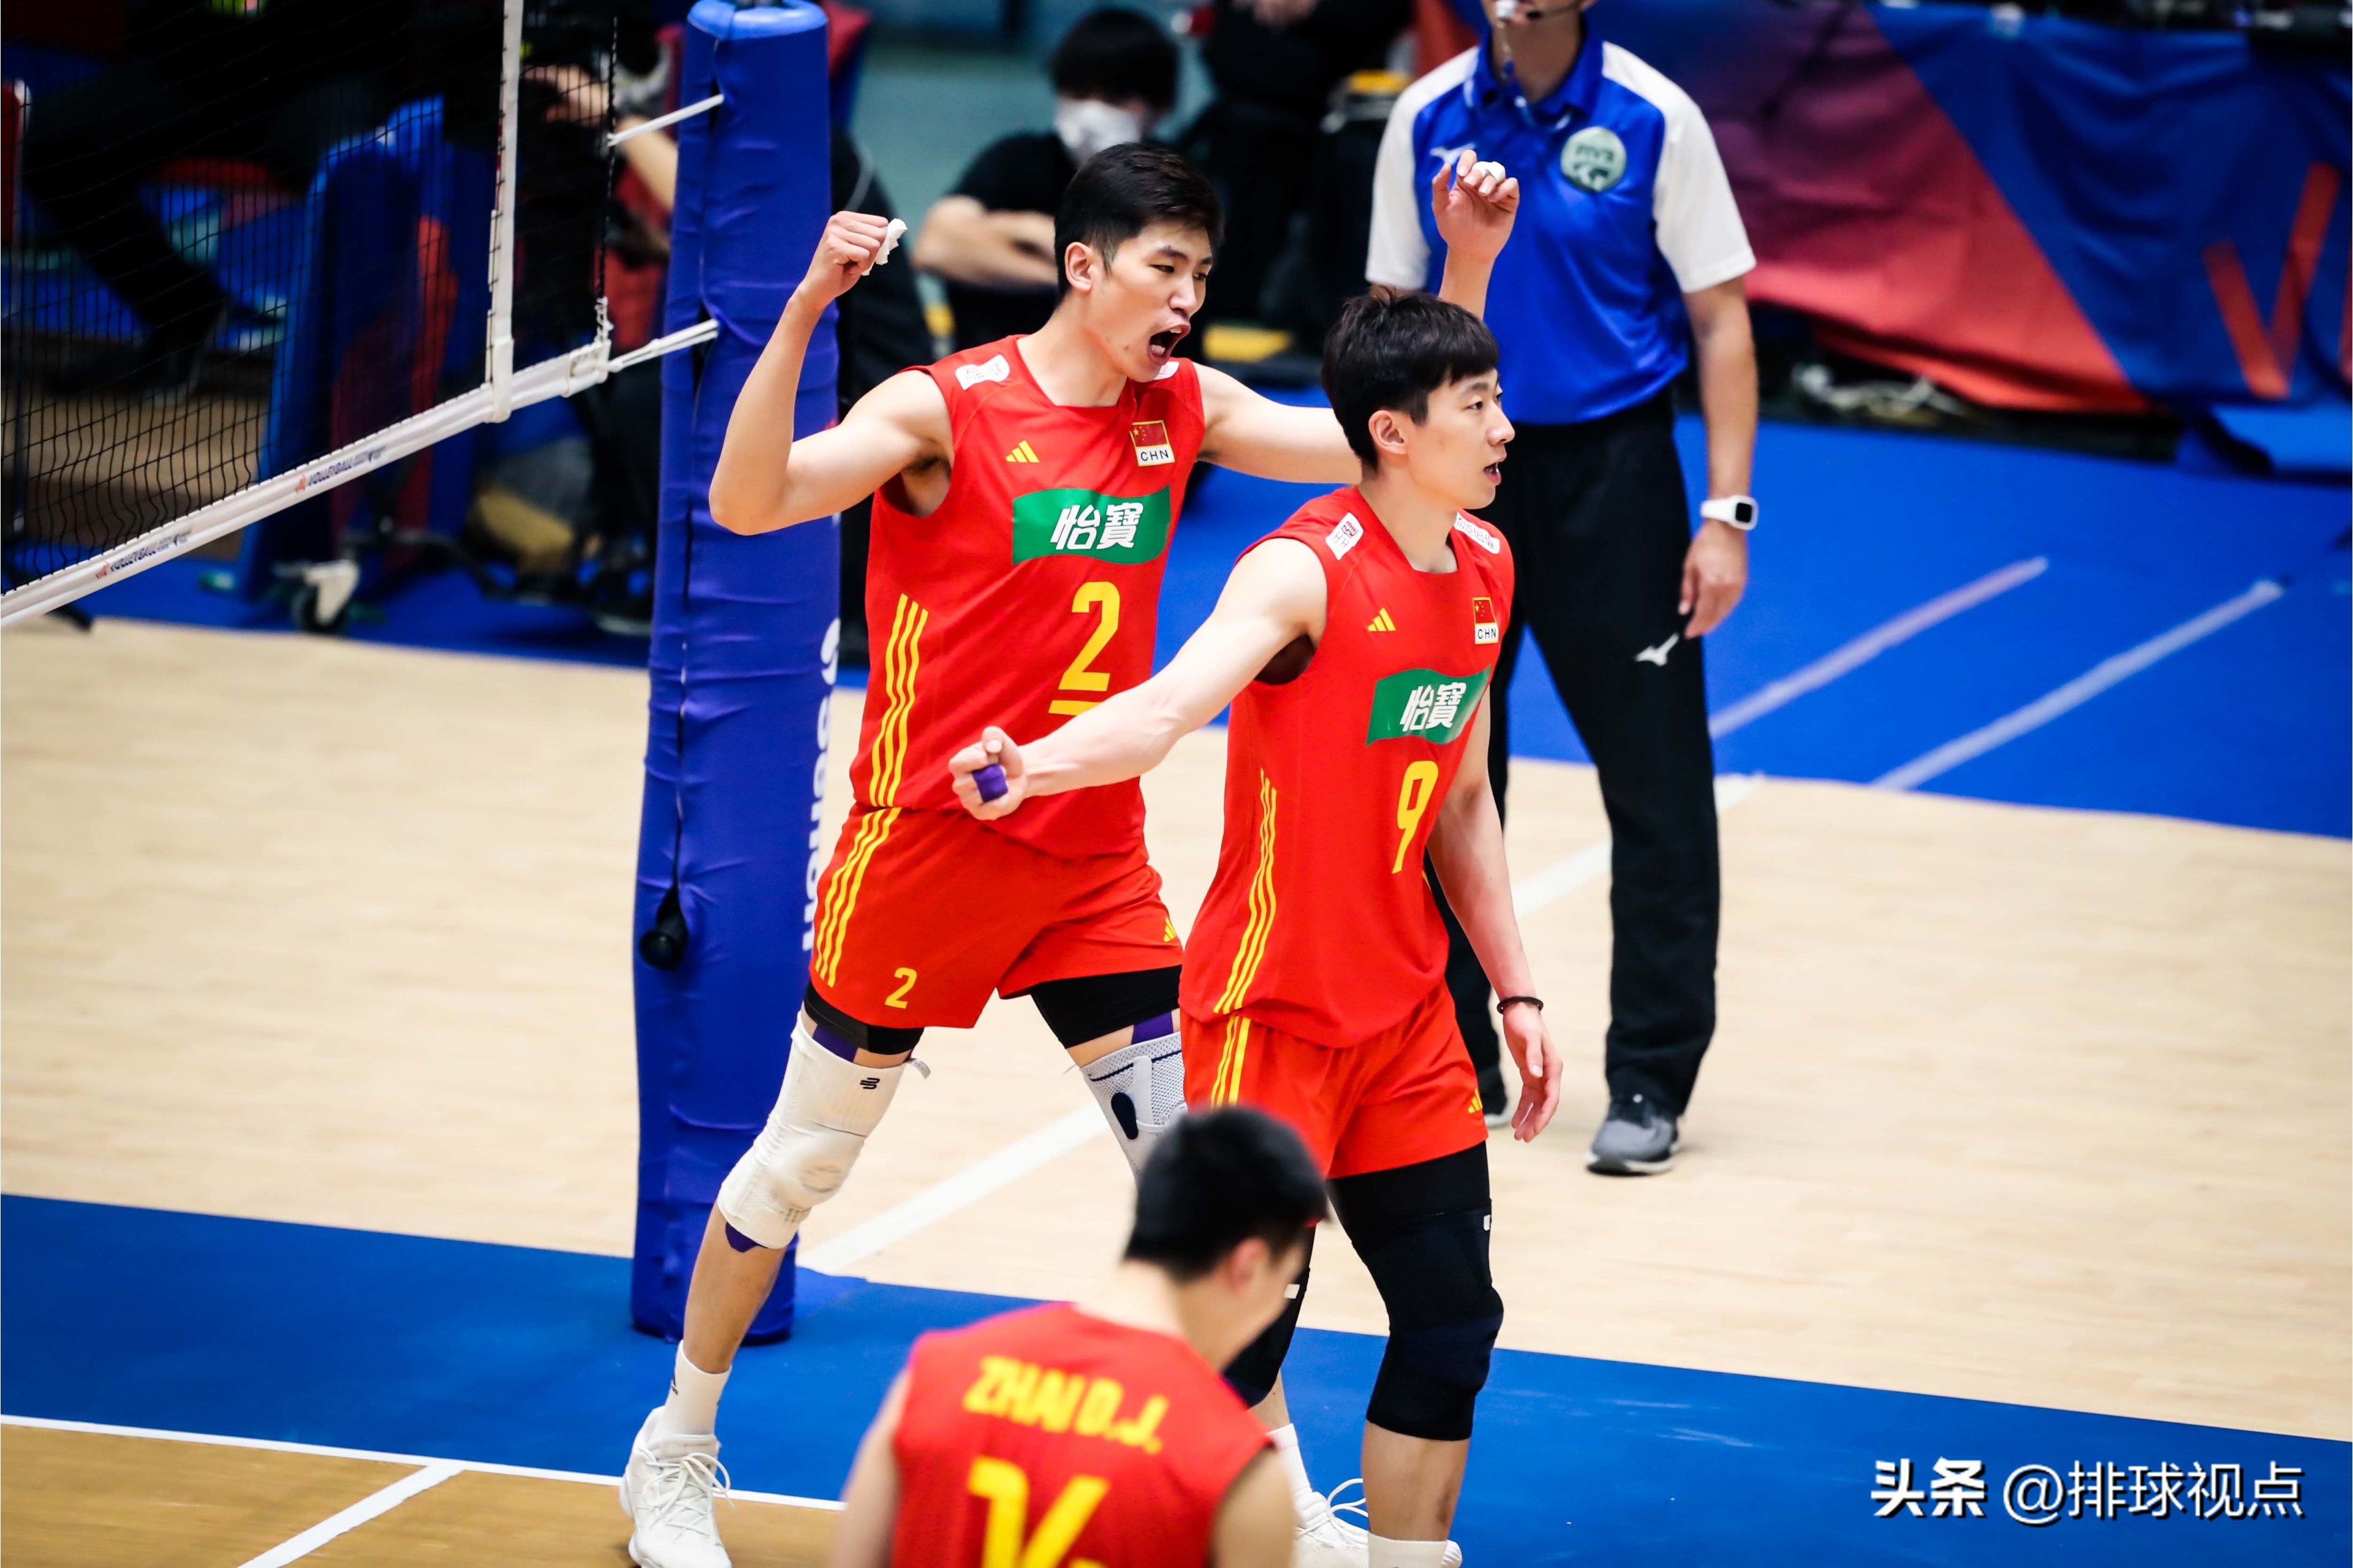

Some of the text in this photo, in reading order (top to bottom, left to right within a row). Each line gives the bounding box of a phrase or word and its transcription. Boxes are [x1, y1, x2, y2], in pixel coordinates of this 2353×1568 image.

[1140, 449, 1169, 461] CHN
[1050, 502, 1144, 550] 怡寶
[1058, 581, 1120, 691] 2
[1477, 628, 1496, 639] CHN
[1400, 682, 1467, 732] 怡寶
[1392, 760, 1439, 874] 9
[885, 968, 917, 1009] 2
